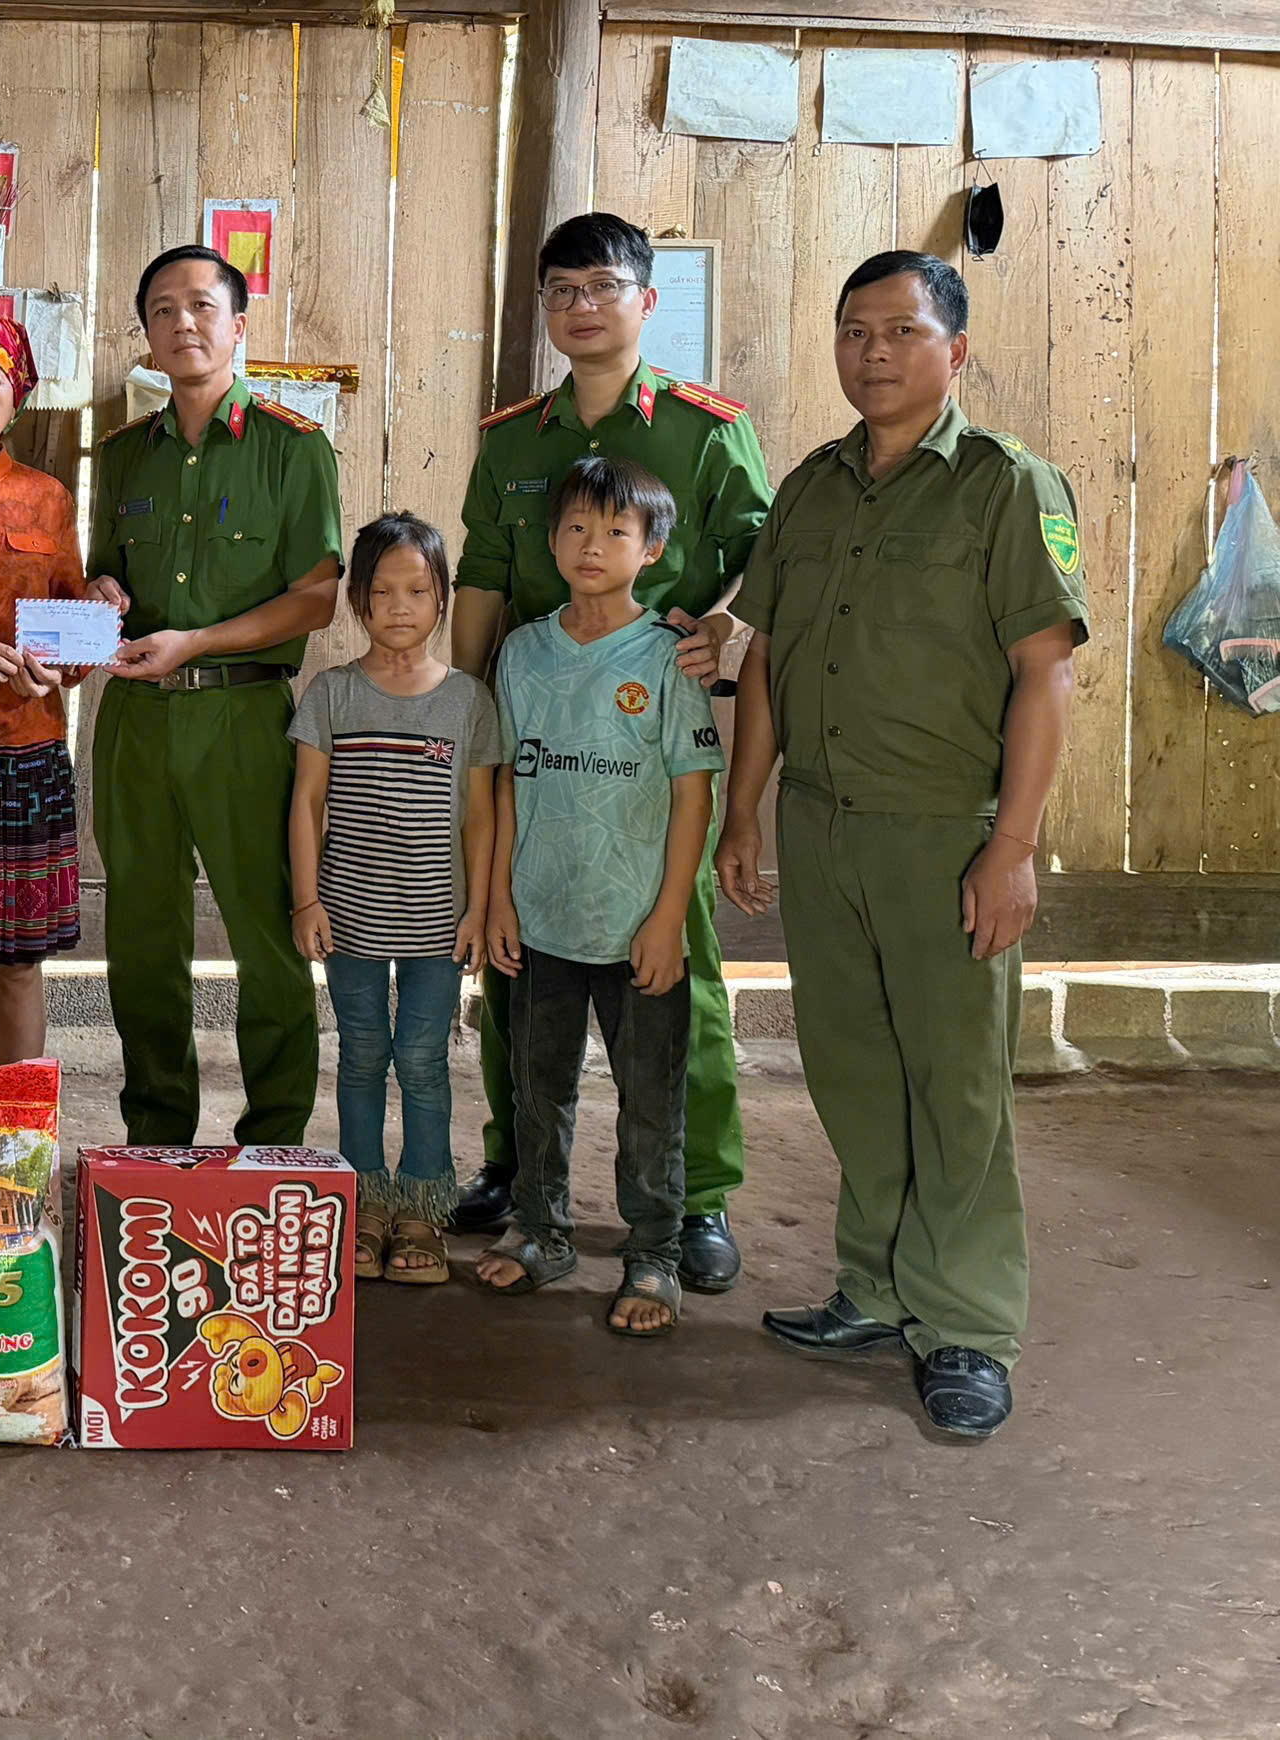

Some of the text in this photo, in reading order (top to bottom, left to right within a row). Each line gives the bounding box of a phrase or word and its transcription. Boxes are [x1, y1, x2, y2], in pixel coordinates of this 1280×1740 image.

[540, 747, 641, 778] TeamViewer
[172, 1259, 211, 1318] 90
[231, 1218, 261, 1302] ĐÃ TO
[261, 1229, 275, 1291] NAY CÒN
[277, 1195, 303, 1326] DAI NGON
[299, 1206, 332, 1314] ĐẬM ĐÀ
[118, 1199, 172, 1409] KOKOMI
[85, 1411, 104, 1443] MỚI
[329, 1418, 337, 1437] CAY
